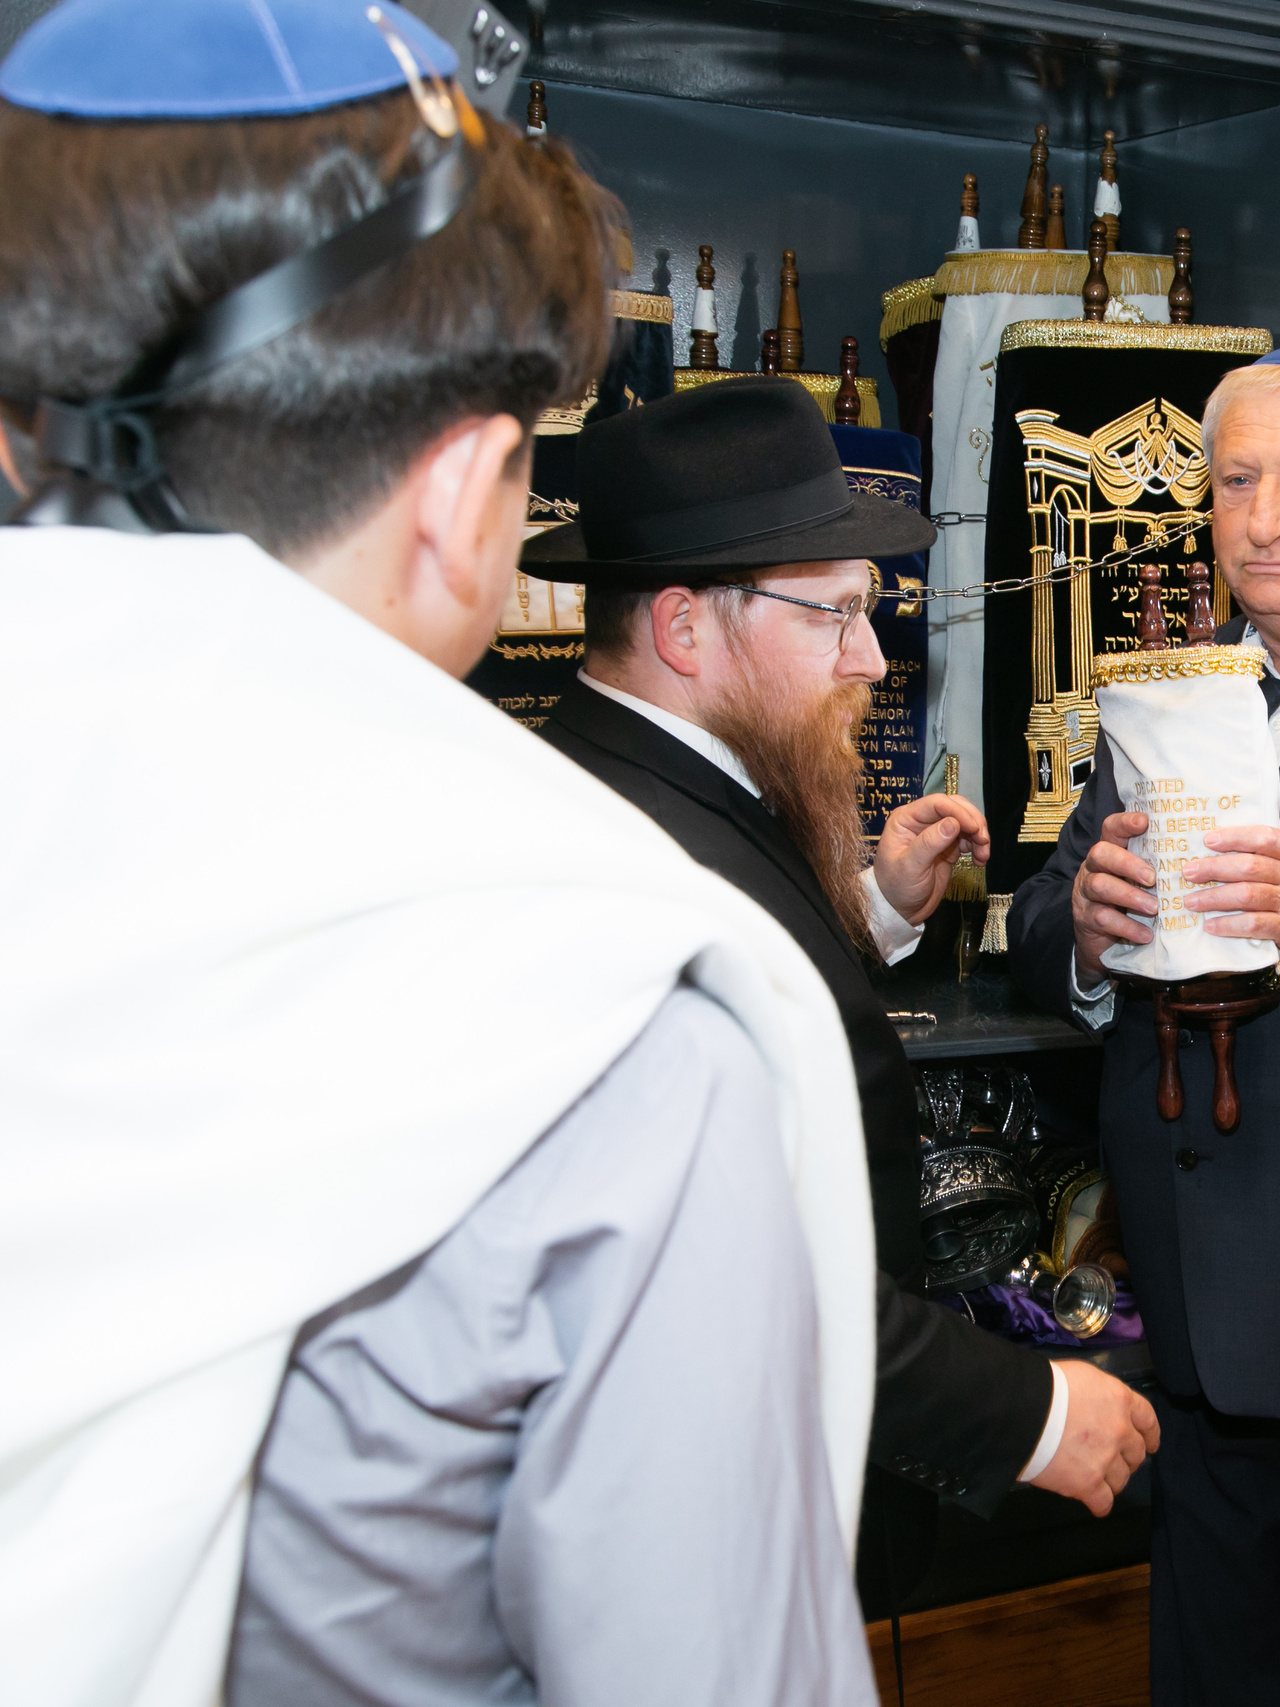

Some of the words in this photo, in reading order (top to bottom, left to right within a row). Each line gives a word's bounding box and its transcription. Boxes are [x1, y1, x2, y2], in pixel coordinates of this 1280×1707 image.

[891, 676, 908, 688] OF
[883, 724, 914, 737] ALAN
[884, 740, 921, 753] FAMILY
[869, 759, 892, 770] ספר
[870, 788, 892, 808] אלן
[1217, 795, 1241, 810] OF
[1166, 816, 1221, 833] BEREL
